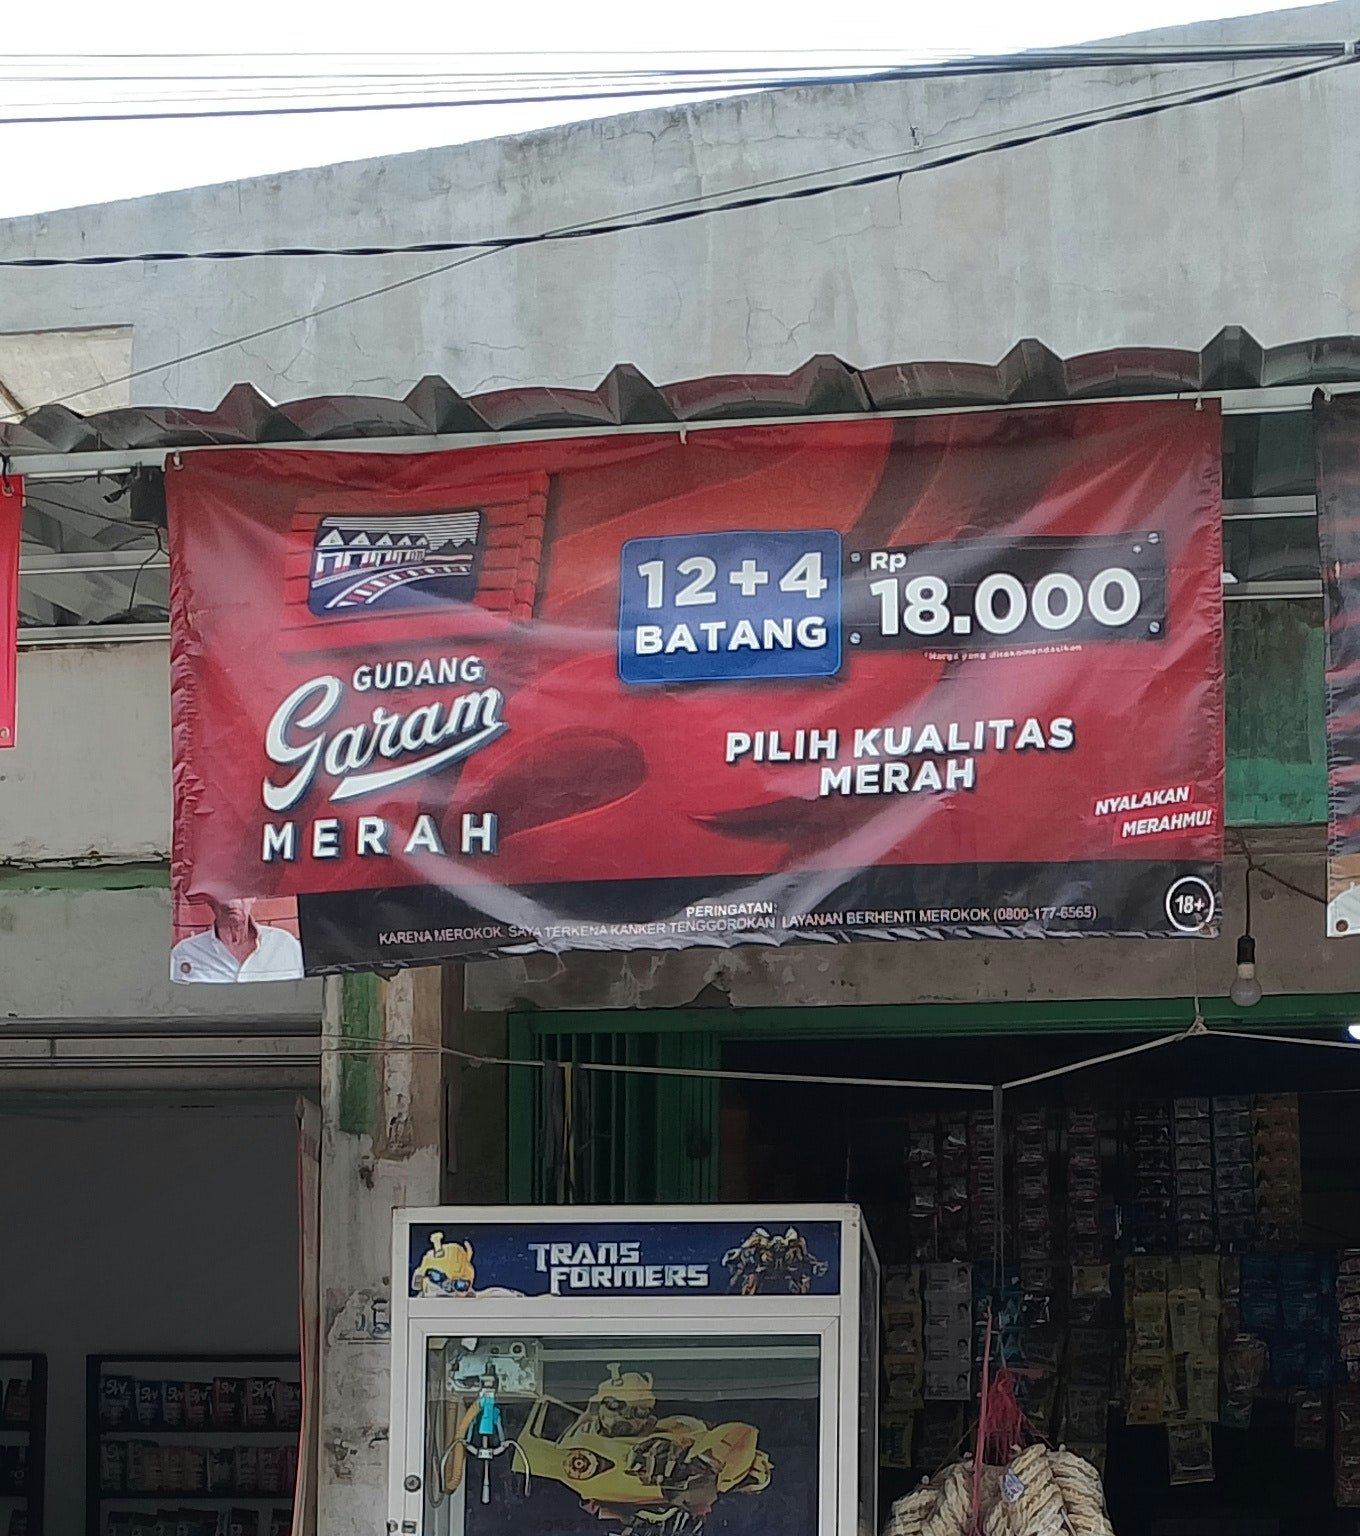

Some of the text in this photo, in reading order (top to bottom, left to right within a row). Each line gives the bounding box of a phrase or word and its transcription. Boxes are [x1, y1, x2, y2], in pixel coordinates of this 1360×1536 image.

[636, 551, 828, 609] 12+4
[870, 551, 908, 573] Rp
[870, 567, 1142, 636] 18.000
[635, 616, 828, 655] BATANG
[352, 656, 485, 692] GUDANG
[262, 674, 511, 812] Garam
[725, 717, 1076, 764] PILIH KUALITAS
[819, 757, 976, 798] MERAH
[1095, 785, 1190, 816] NYALAKAN
[262, 812, 499, 862] MERAH
[1122, 808, 1212, 838] MERAHMU!
[686, 901, 778, 918] PERINGATAN:
[1174, 894, 1206, 915] 18+
[378, 930, 433, 946] KARENA
[508, 925, 544, 939] SAYA
[544, 923, 608, 938] TERKENA
[610, 921, 666, 936] KANKER
[782, 912, 843, 929] LAYANAN
[846, 909, 915, 926] BERHENTI
[919, 906, 991, 923] MEROKOK
[527, 1241, 642, 1273] TRANS
[549, 1264, 710, 1295] FORMERS
